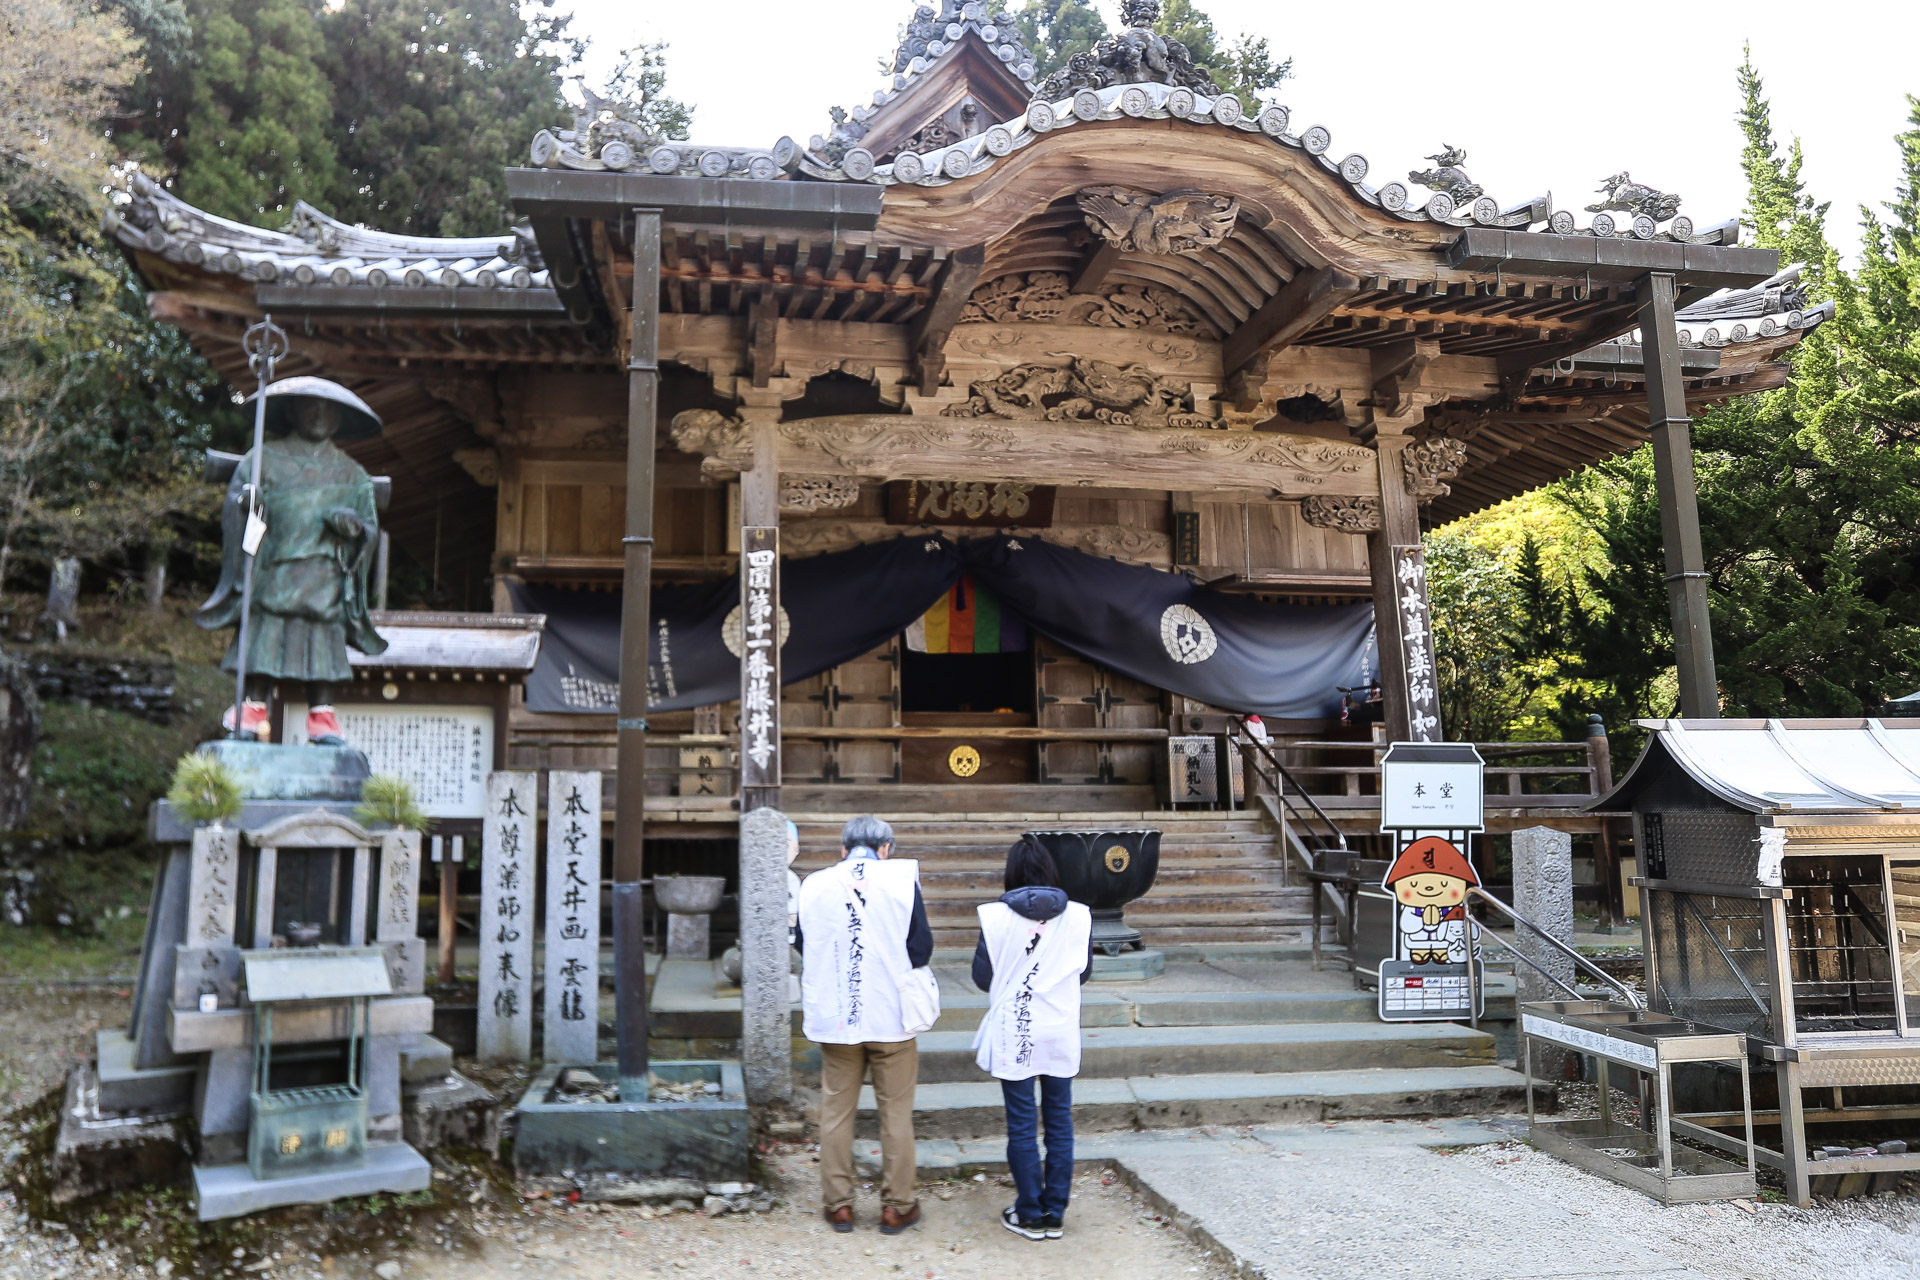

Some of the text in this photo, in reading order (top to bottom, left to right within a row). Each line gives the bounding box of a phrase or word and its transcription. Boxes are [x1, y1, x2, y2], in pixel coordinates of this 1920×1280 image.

[1398, 557, 1438, 743] 御本尊薬師如
[1414, 782, 1453, 798] 本堂
